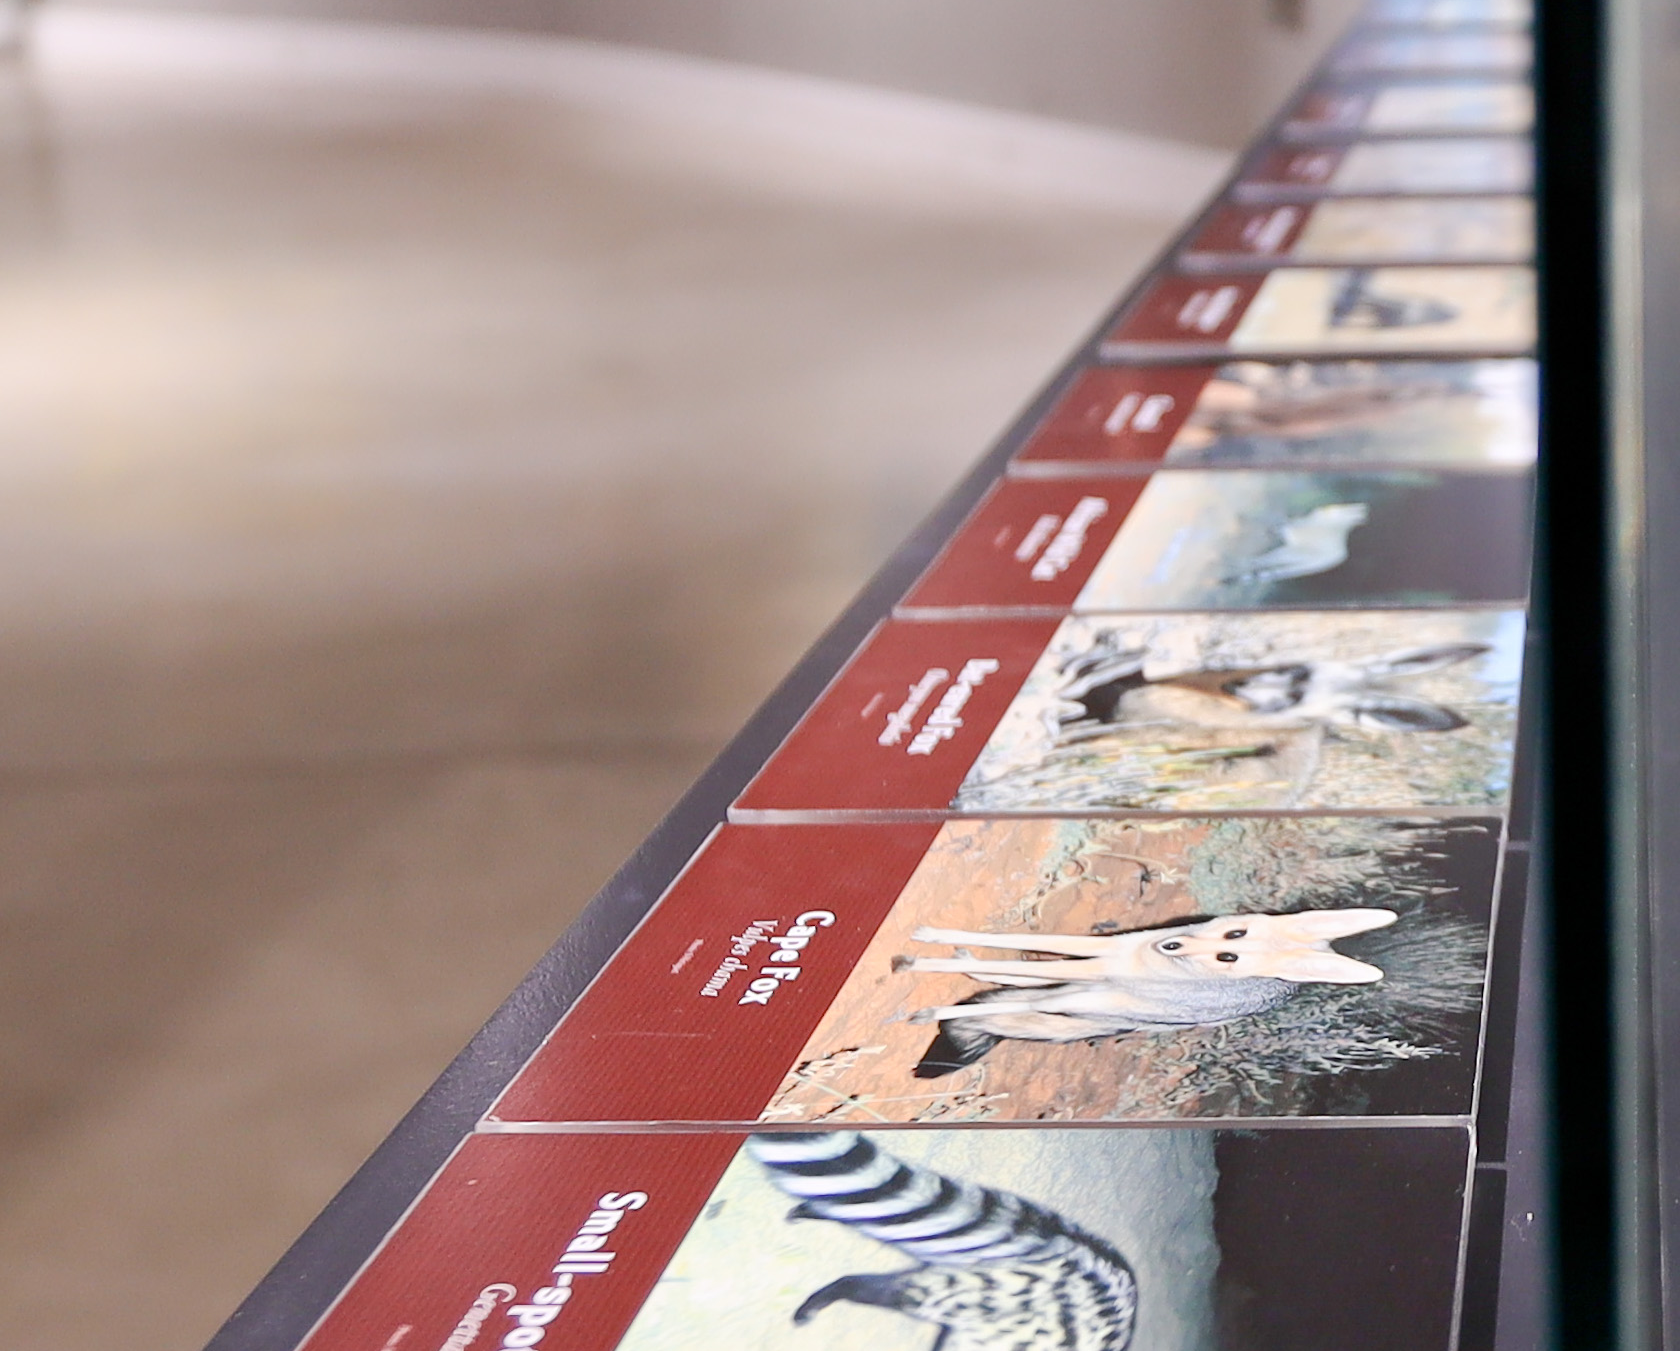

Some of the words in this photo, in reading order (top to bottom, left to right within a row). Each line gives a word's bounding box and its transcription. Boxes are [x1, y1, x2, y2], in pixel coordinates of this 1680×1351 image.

[730, 919, 780, 957] Vulpes
[769, 909, 837, 963] Cape
[699, 955, 749, 998] chama
[737, 965, 803, 1006] Fox
